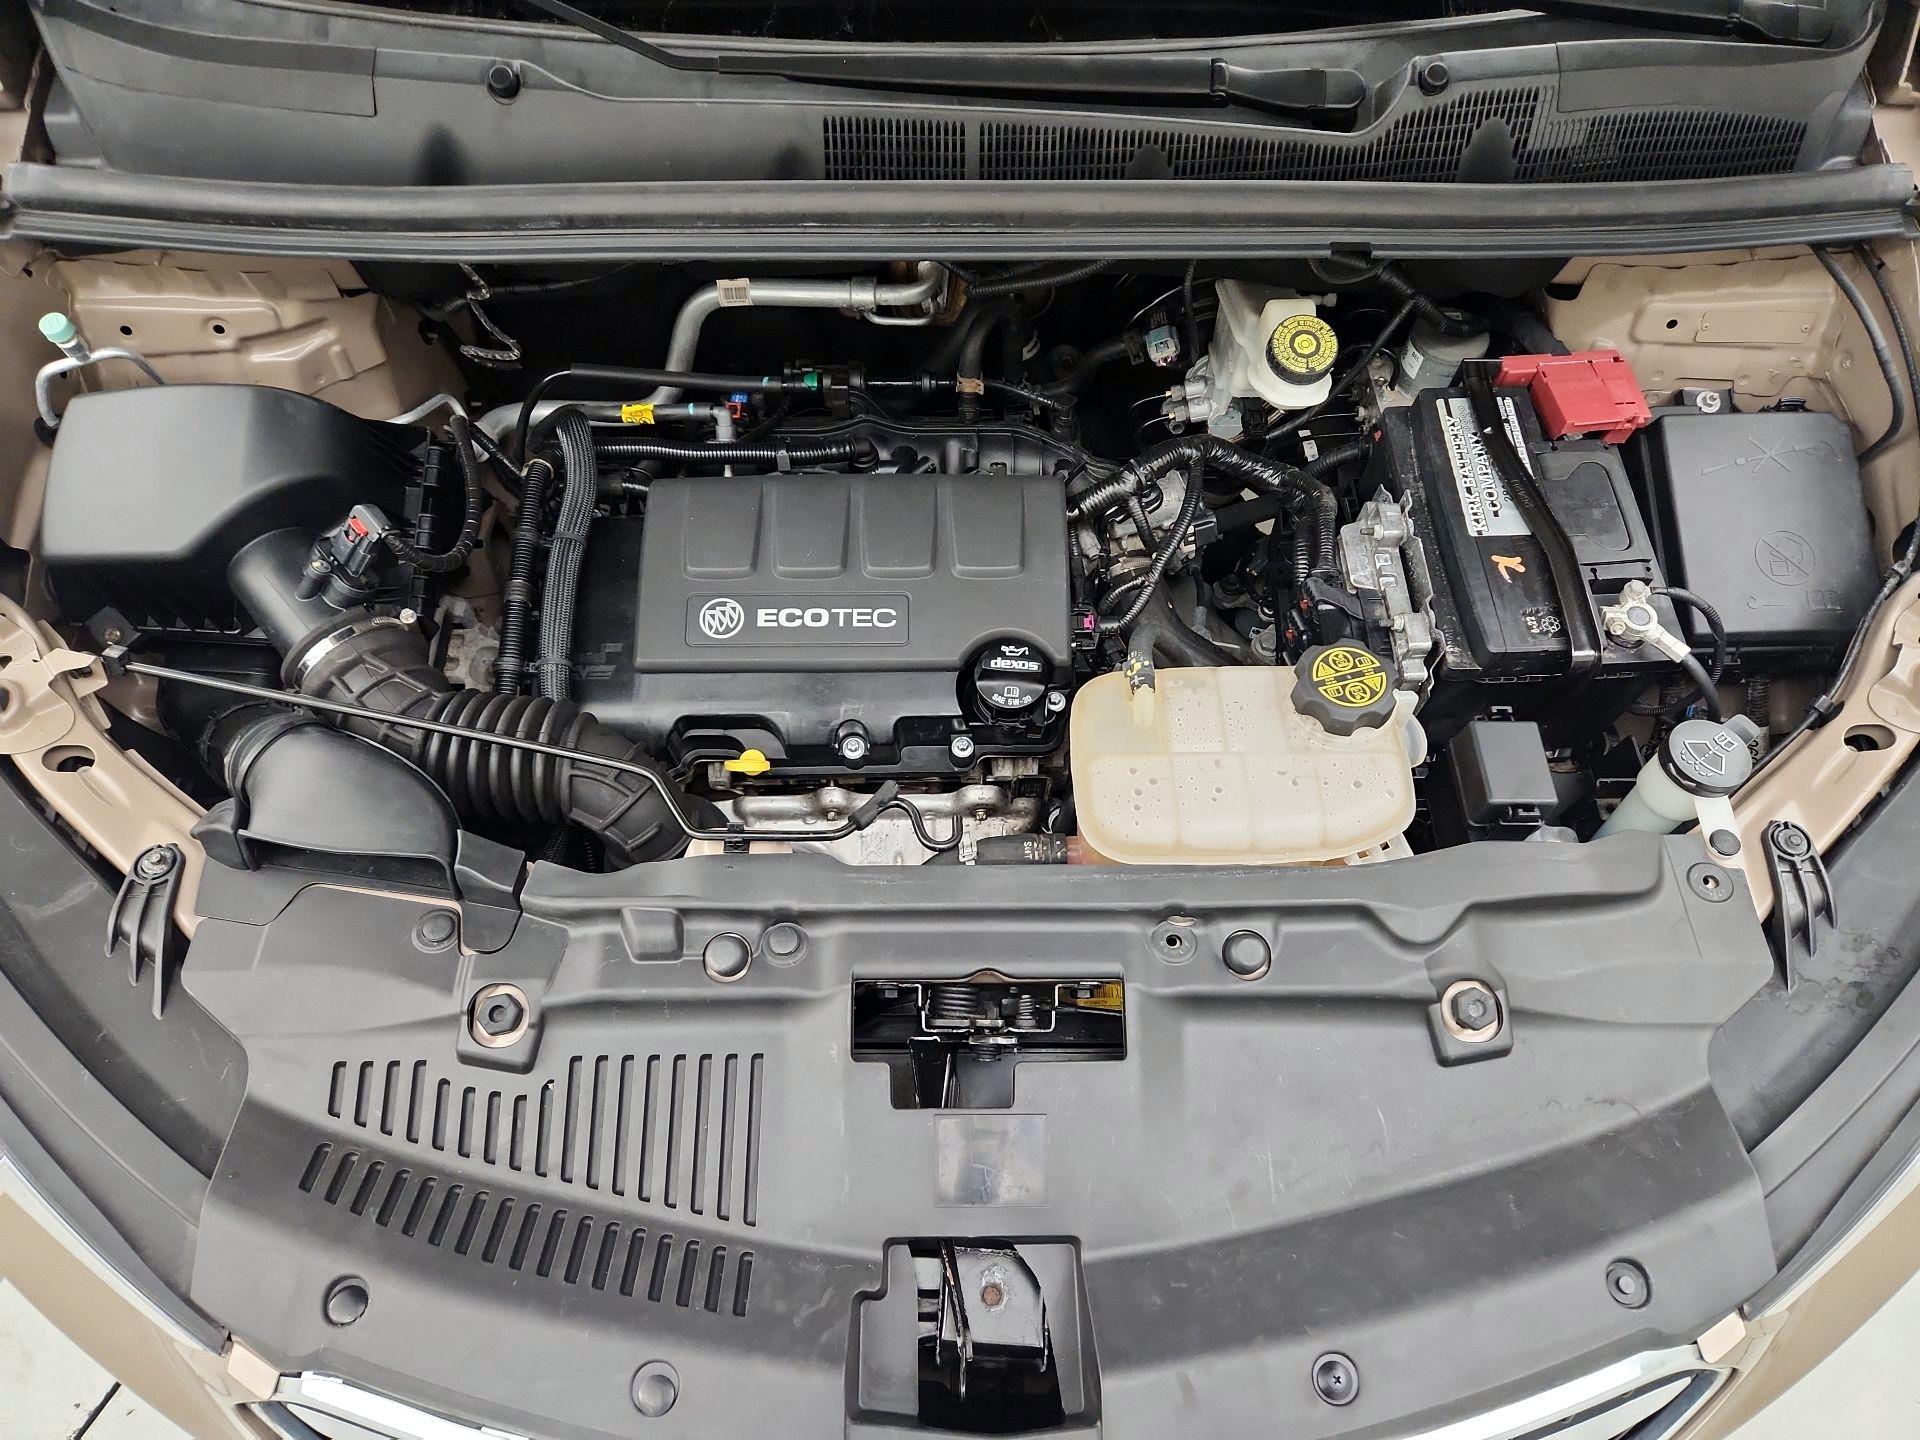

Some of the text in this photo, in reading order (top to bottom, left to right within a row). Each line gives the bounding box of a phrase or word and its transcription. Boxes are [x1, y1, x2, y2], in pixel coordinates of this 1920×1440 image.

[1445, 415, 1477, 488] BATTERY
[1468, 432, 1502, 511] COMPANY
[1465, 491, 1489, 532] KIRK
[757, 608, 896, 628] ECOTEC
[991, 657, 1040, 670] dexos
[992, 694, 1032, 705] SAE 5W-30
